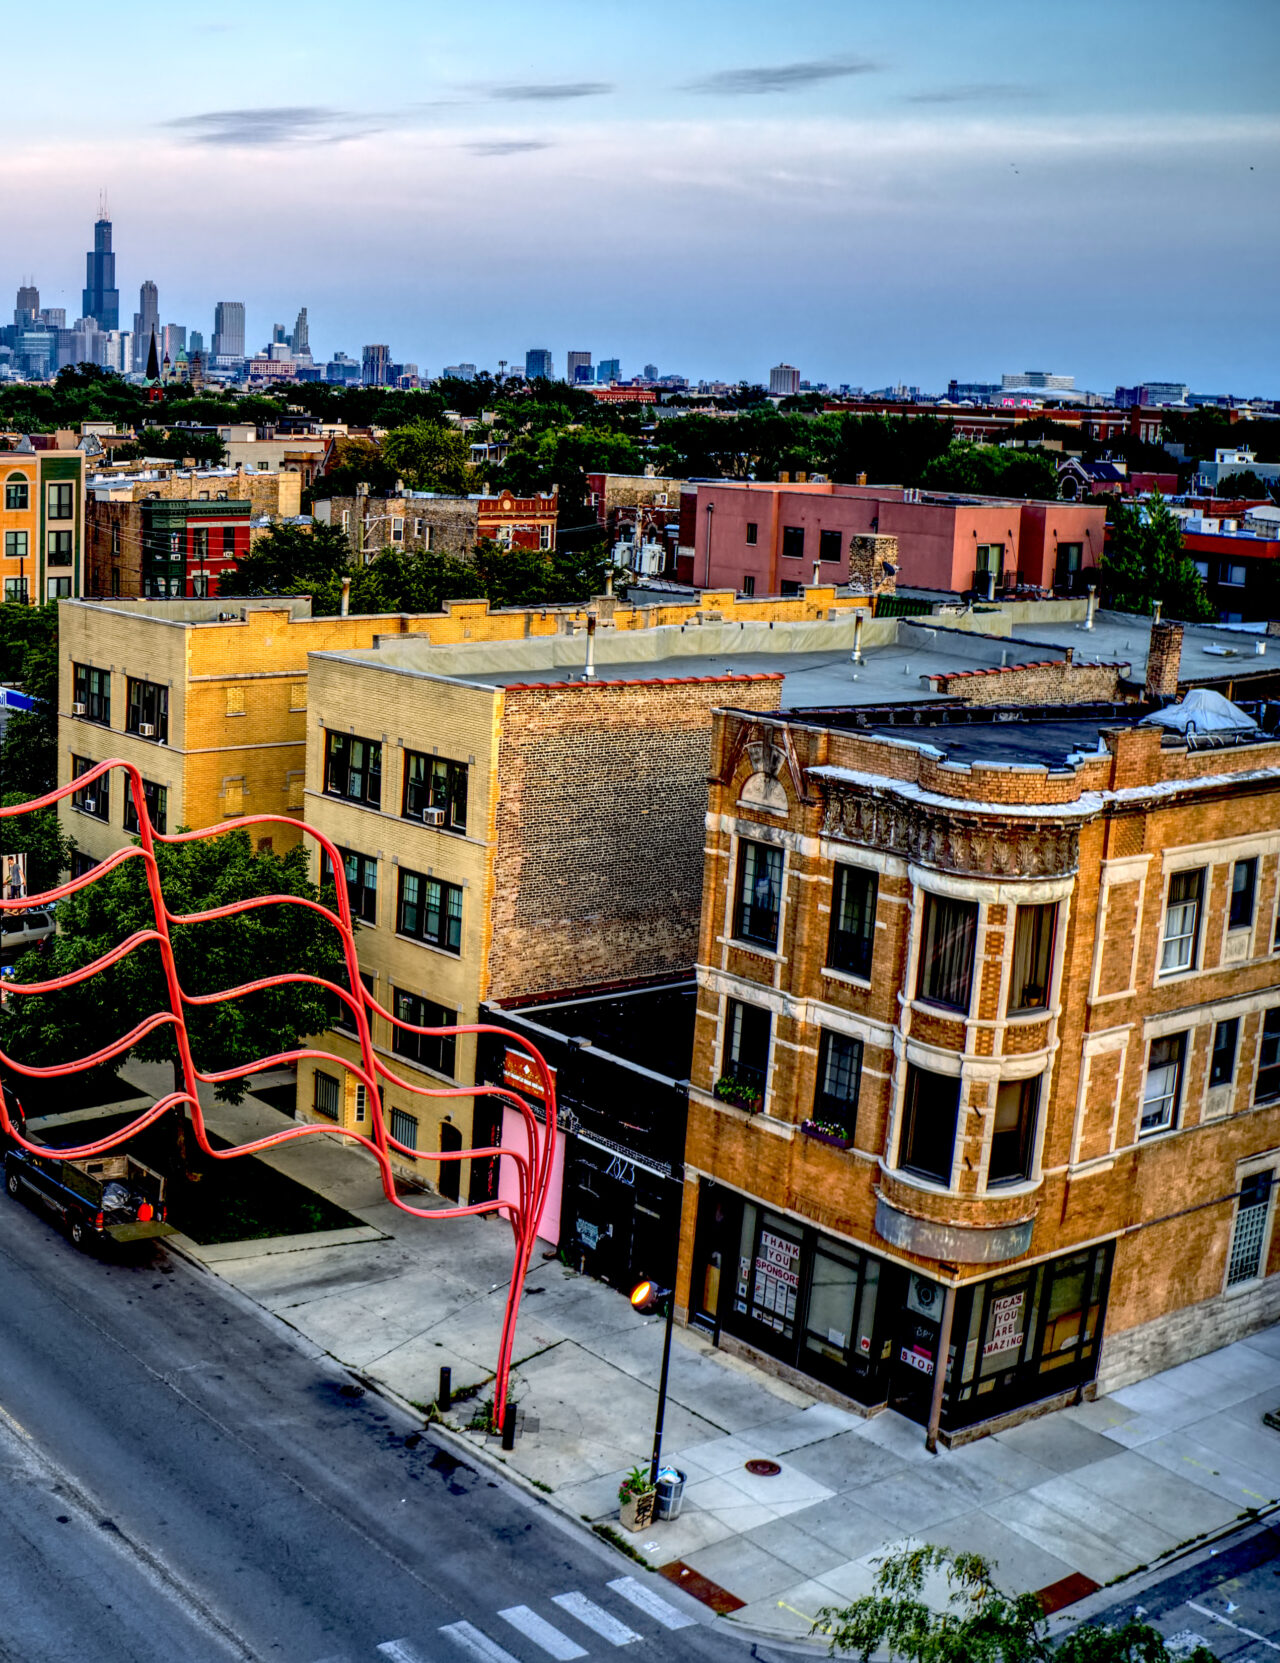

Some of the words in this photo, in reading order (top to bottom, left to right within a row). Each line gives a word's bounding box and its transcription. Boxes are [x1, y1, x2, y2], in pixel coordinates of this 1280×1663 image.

[763, 1233, 799, 1257] THANK
[768, 1249, 789, 1266] YOU
[997, 1310, 1017, 1322] YOU
[994, 1323, 1013, 1338] ARE
[983, 1335, 1023, 1355] AMAZING
[901, 1350, 933, 1374] STOP
